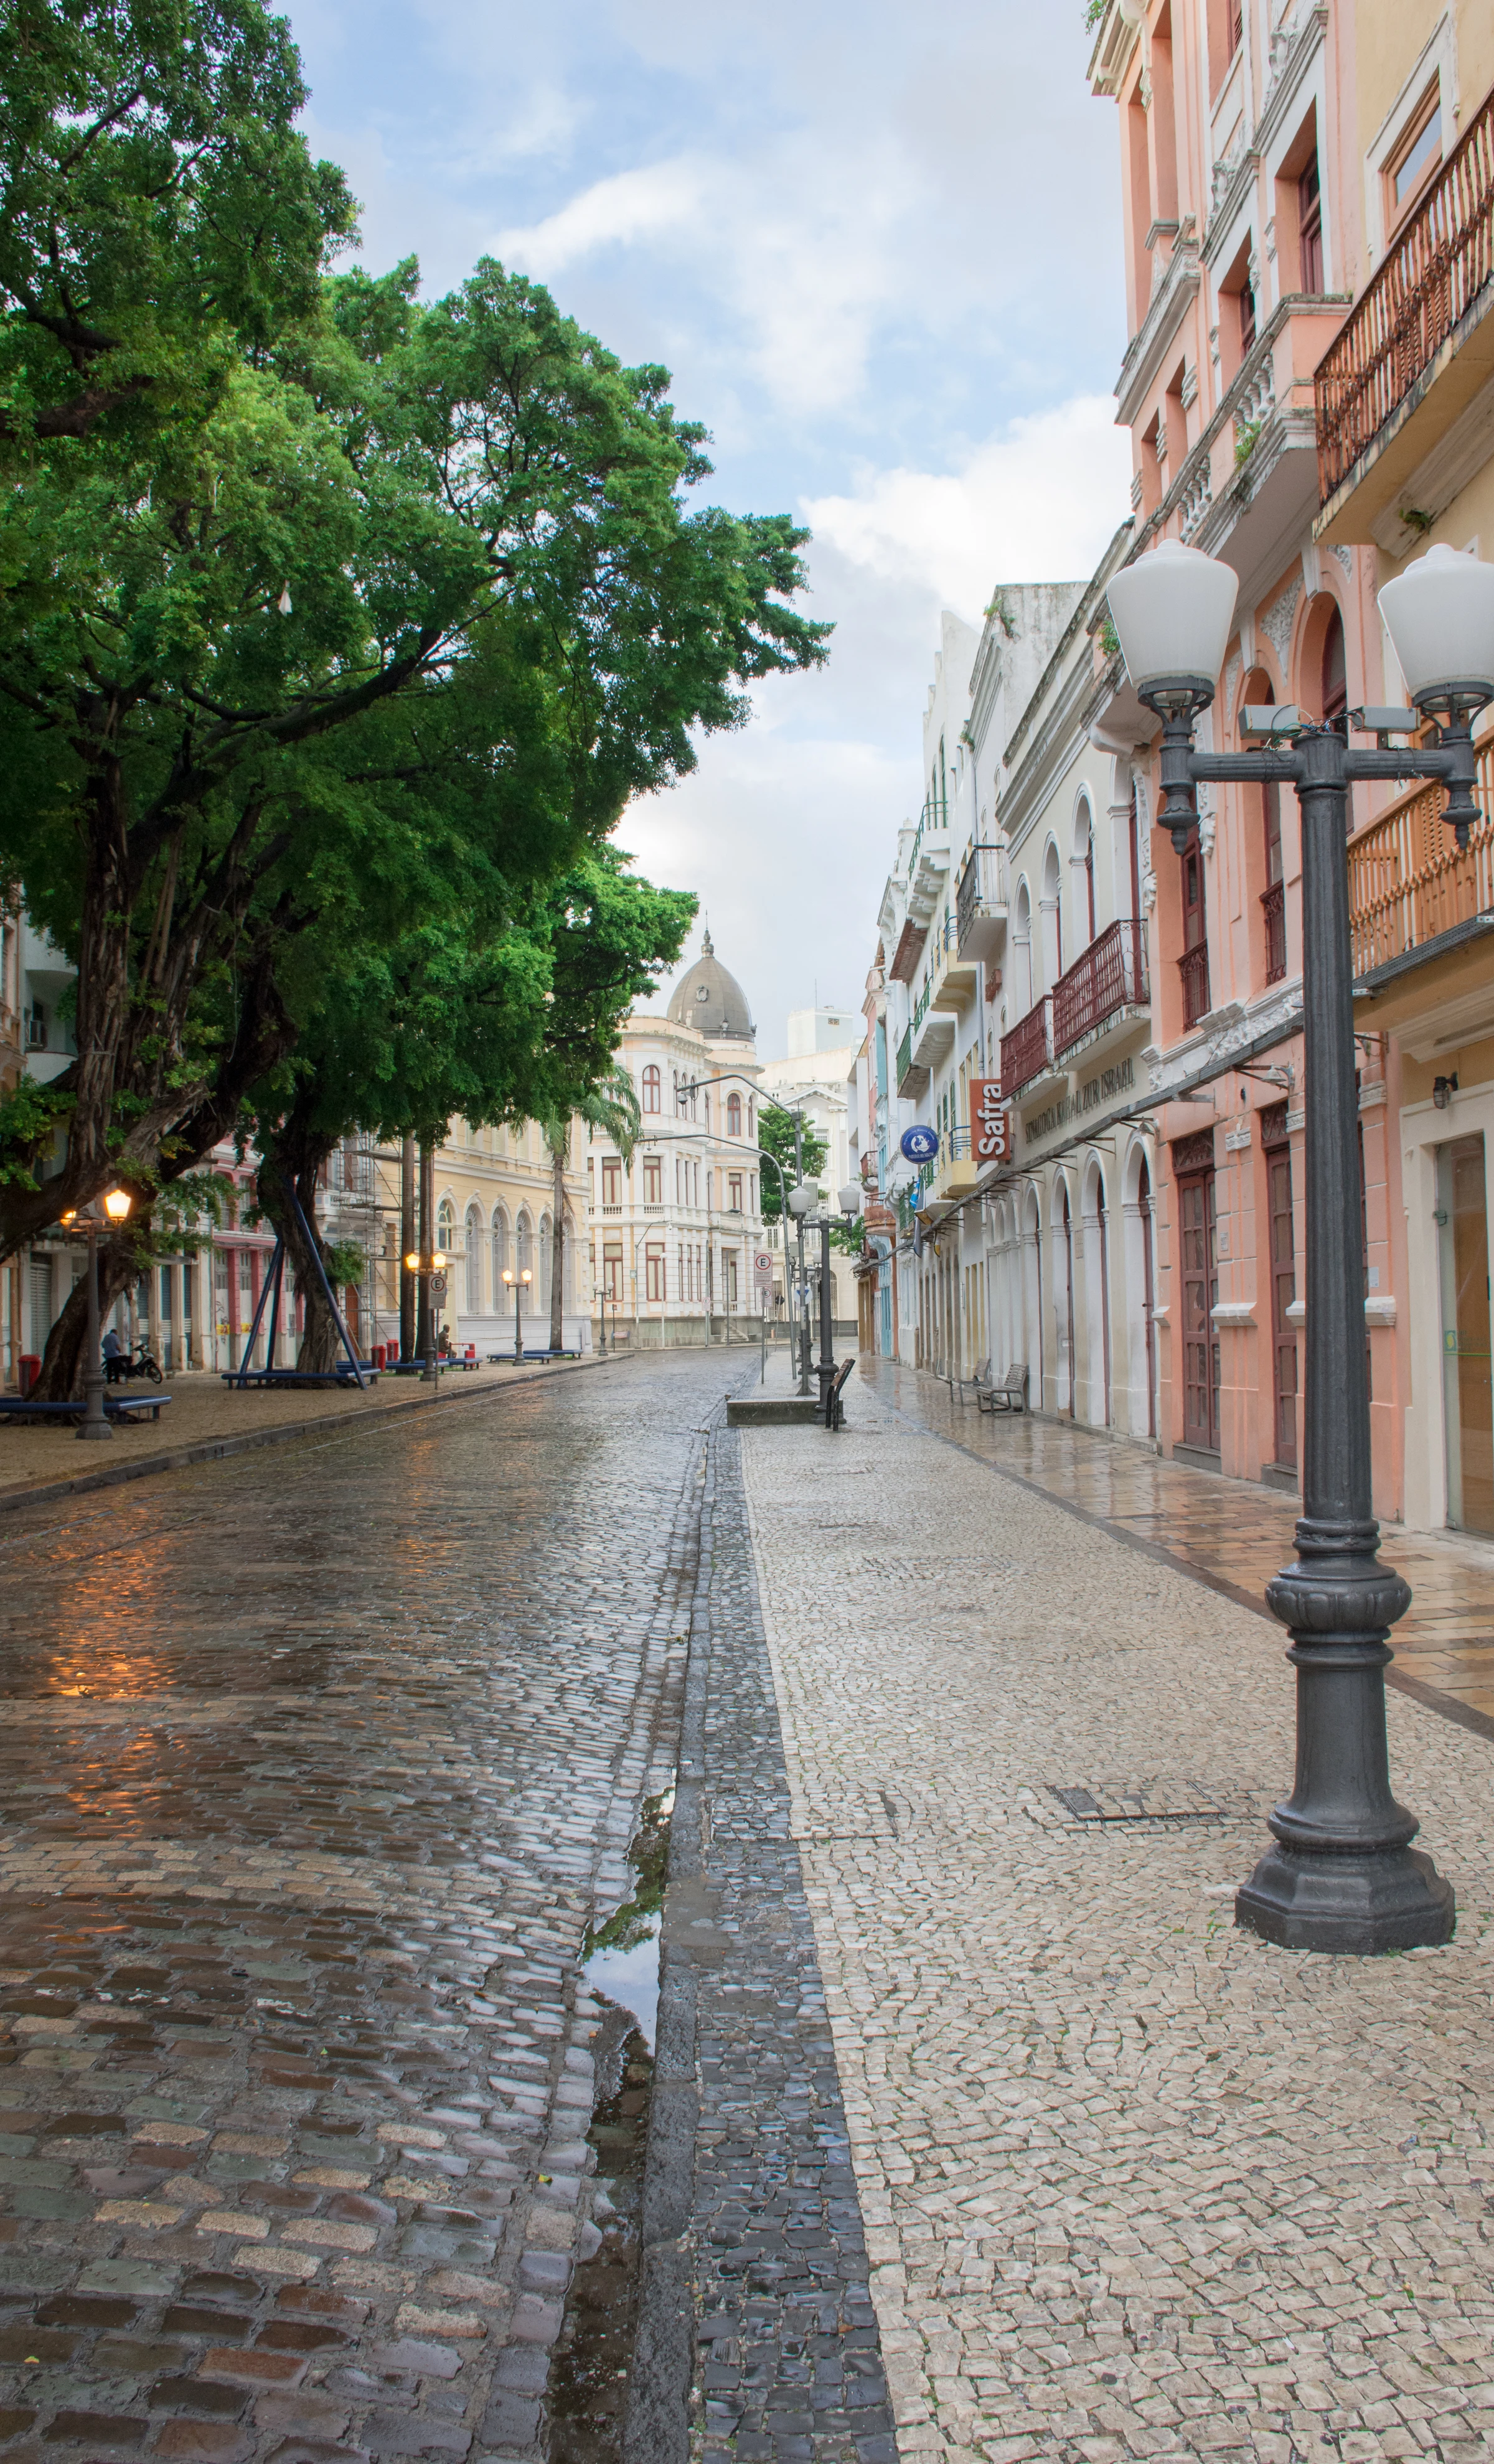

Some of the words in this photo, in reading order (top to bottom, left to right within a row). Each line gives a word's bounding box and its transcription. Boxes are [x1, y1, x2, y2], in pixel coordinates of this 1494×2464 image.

[977, 1084, 1005, 1155] Safra
[760, 1258, 766, 1267] E
[435, 1280, 440, 1288] E
